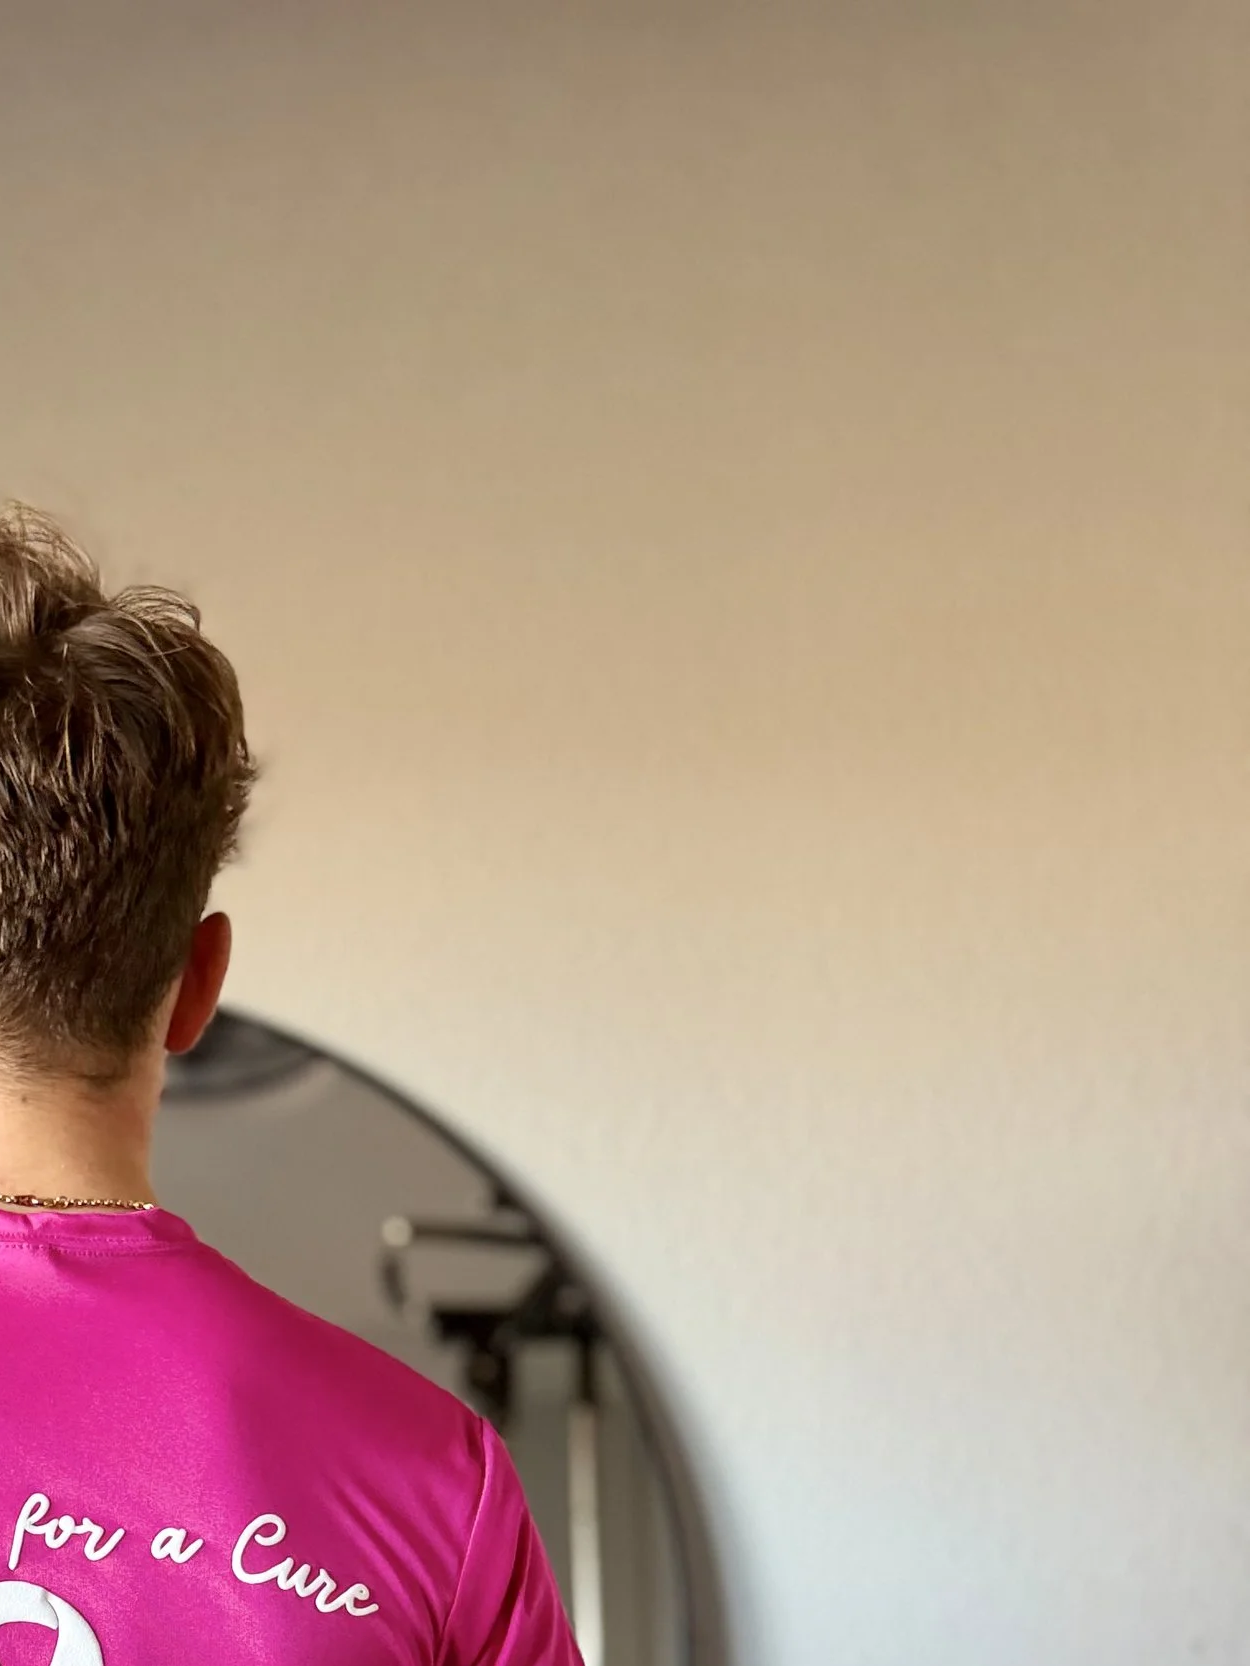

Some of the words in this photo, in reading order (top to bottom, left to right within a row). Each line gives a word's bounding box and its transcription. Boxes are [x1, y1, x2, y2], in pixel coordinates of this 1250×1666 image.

[7, 1491, 126, 1572] for
[149, 1526, 205, 1565] a
[230, 1512, 380, 1618] Cure
